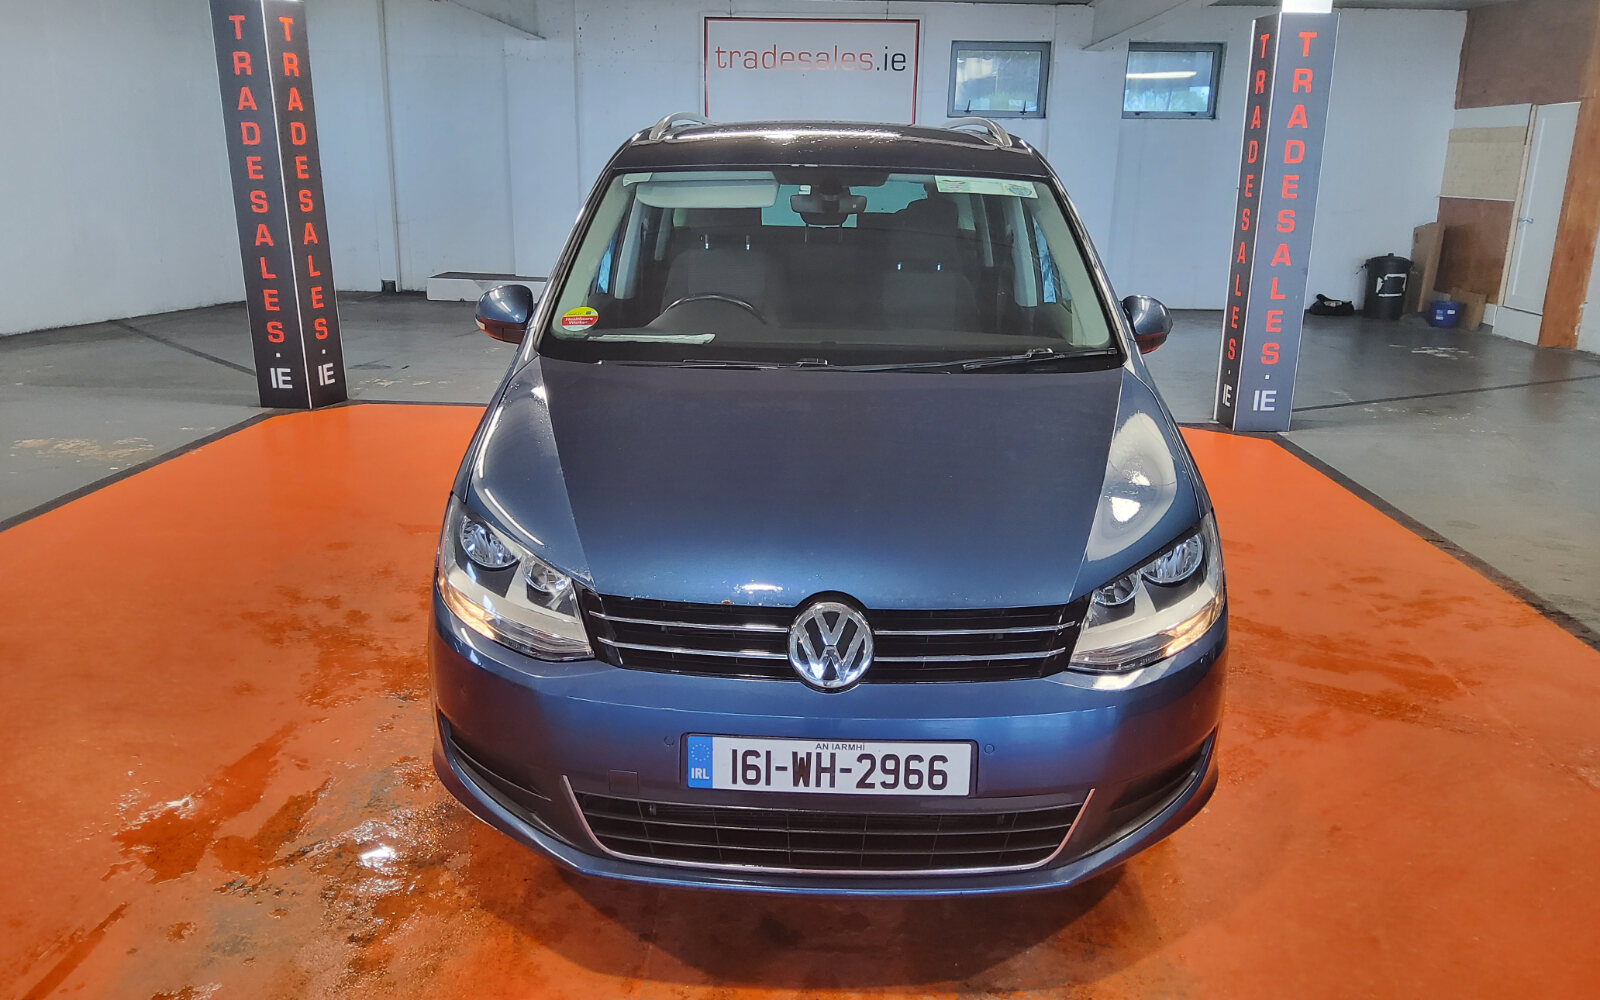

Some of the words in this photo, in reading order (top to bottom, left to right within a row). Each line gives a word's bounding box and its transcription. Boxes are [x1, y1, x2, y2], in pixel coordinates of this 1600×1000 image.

[715, 44, 906, 72] tradesales.ie
[691, 767, 710, 780] IRL
[731, 748, 949, 791] 161-WH-2966
